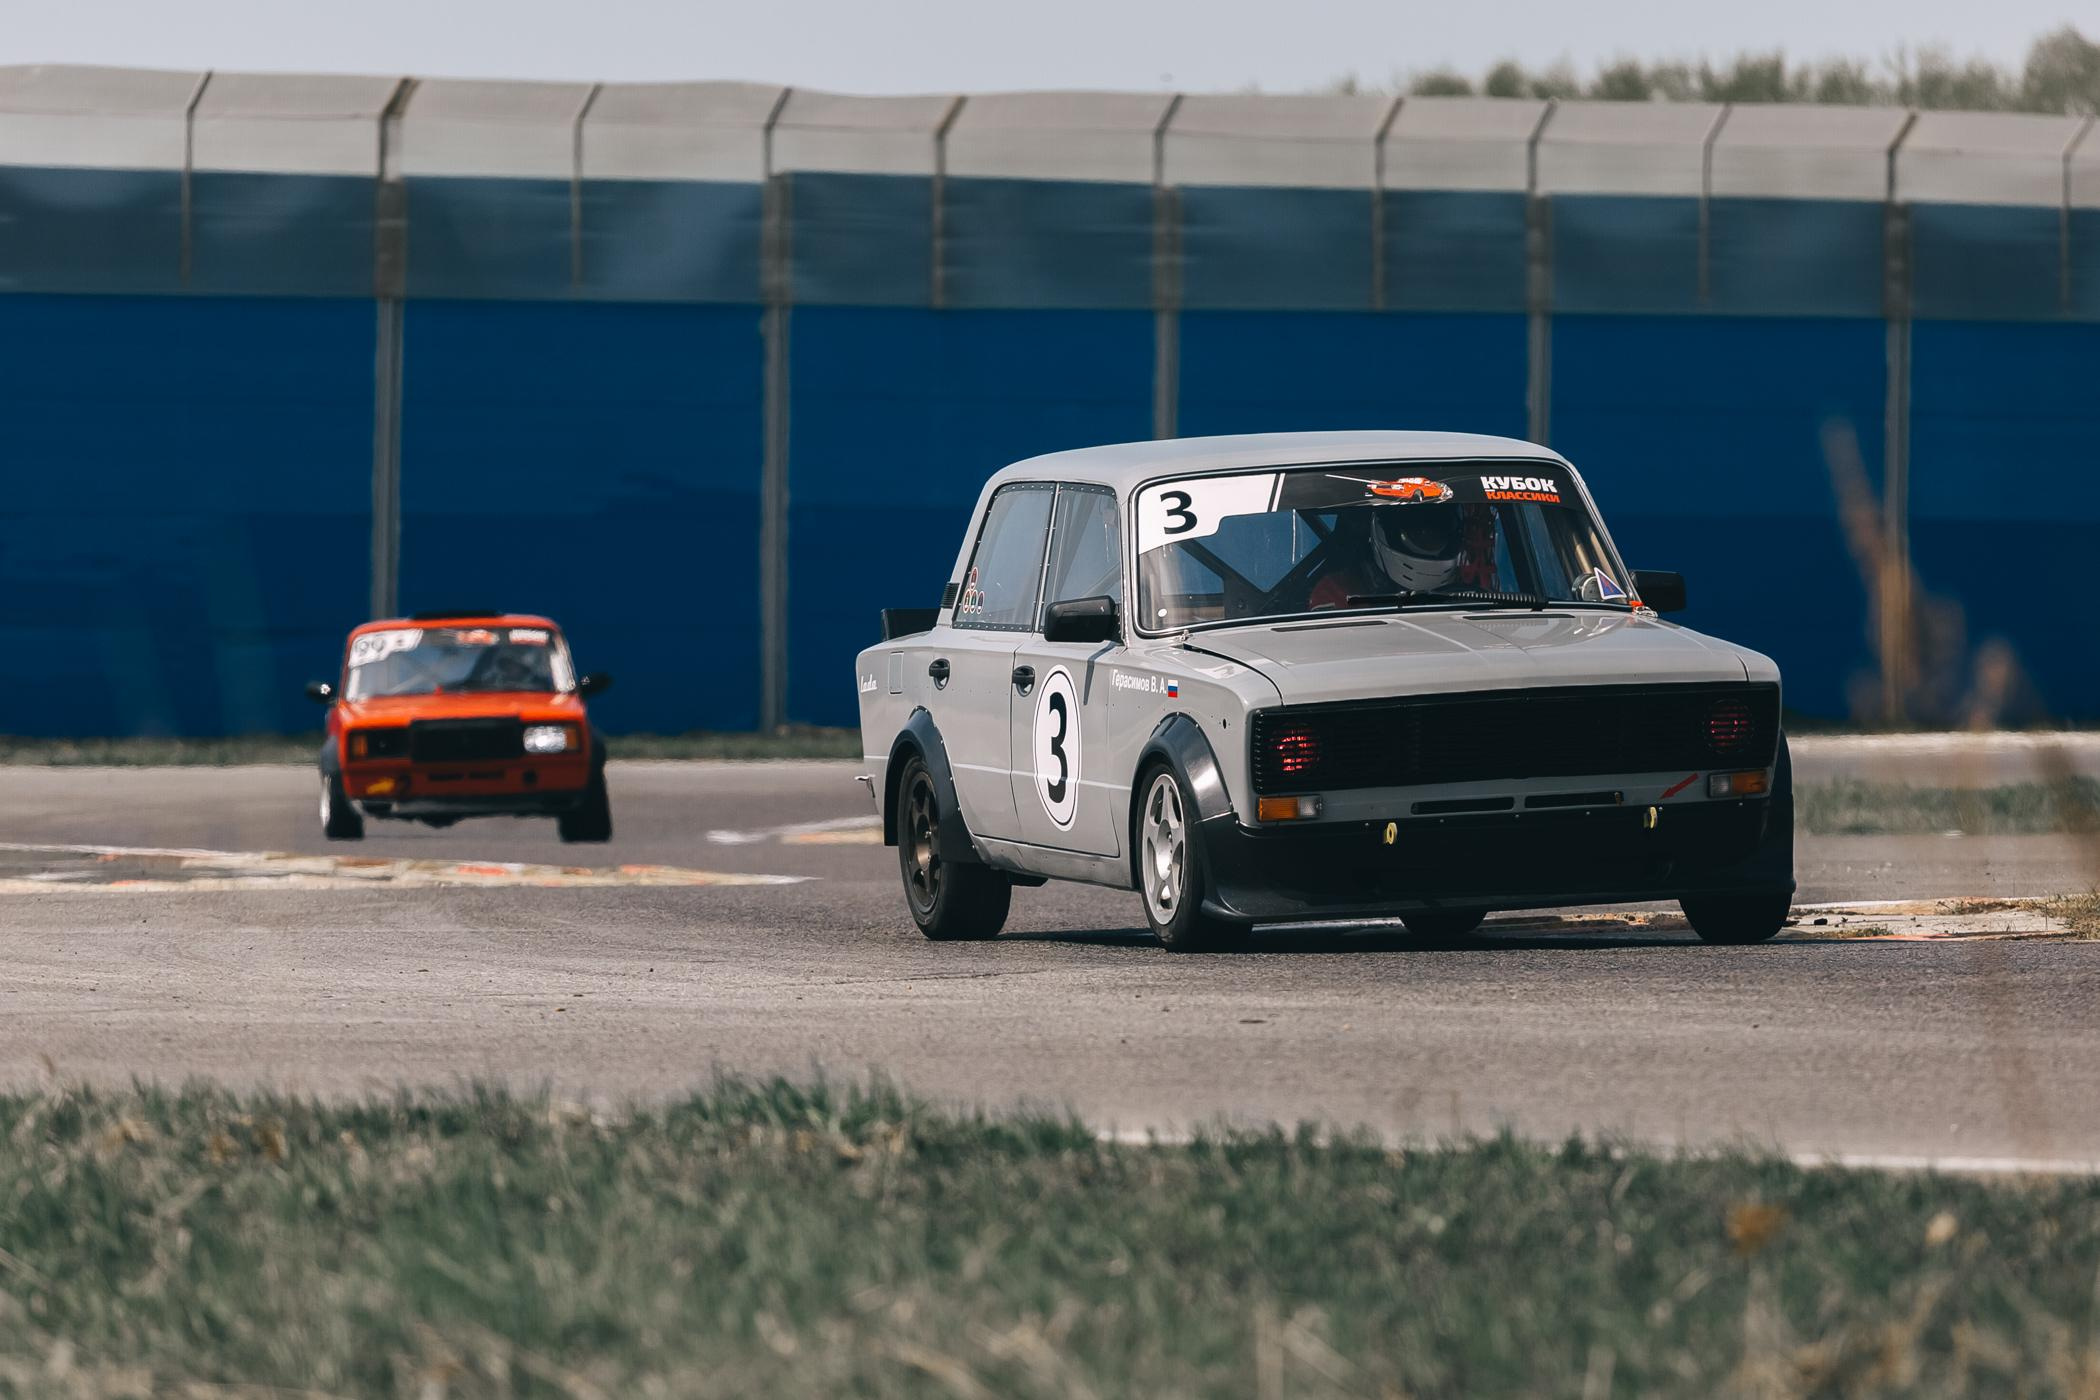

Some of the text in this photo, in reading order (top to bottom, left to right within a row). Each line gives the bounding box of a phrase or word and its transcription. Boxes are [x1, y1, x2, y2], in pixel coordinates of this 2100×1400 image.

[1481, 476, 1557, 492] КУБОК
[1486, 491, 1560, 503] КЛАССИКИ
[1159, 491, 1197, 534] 3
[1111, 669, 1150, 692] Герасимов
[1048, 692, 1067, 803] 3
